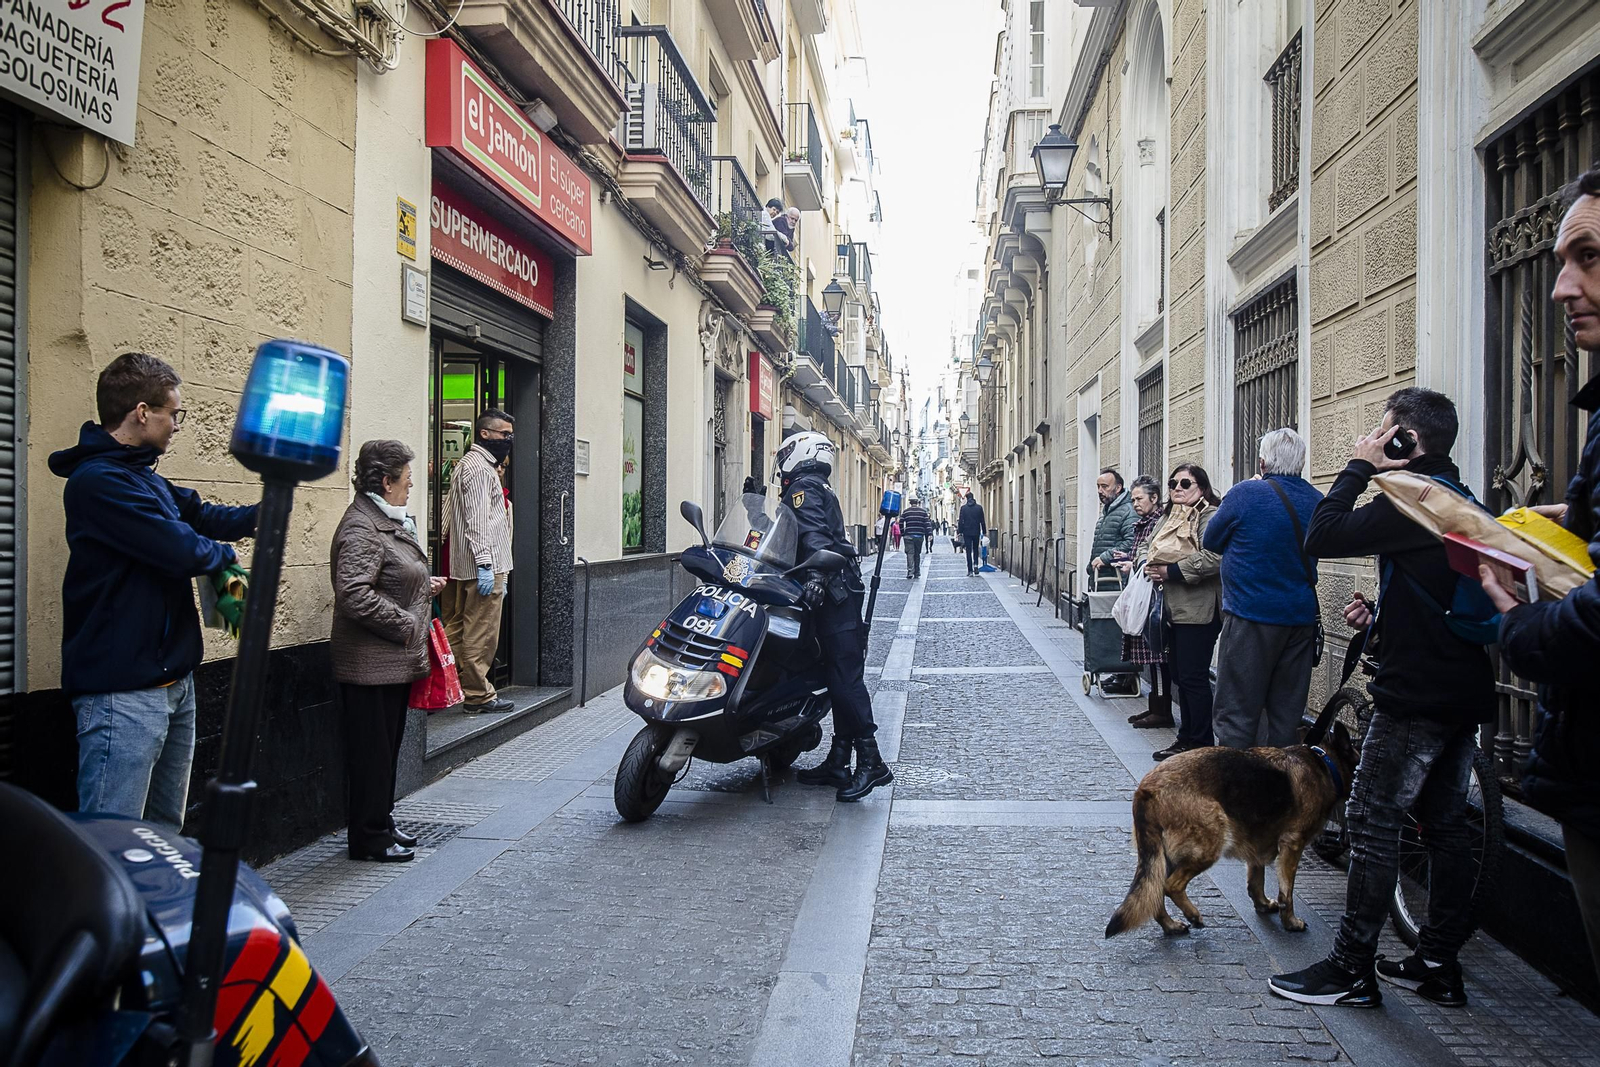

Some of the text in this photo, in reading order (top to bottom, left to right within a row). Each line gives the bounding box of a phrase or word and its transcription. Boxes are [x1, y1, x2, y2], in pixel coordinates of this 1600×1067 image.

[0, 50, 112, 124] GOLOSINAS
[468, 92, 537, 182] el jamón
[550, 154, 585, 207] El súper
[431, 195, 539, 287] SUPERMERCADO
[550, 194, 586, 238] cercano
[682, 615, 717, 636] 091
[691, 586, 758, 619] POLICIA
[131, 827, 201, 879] PIAGGIO
